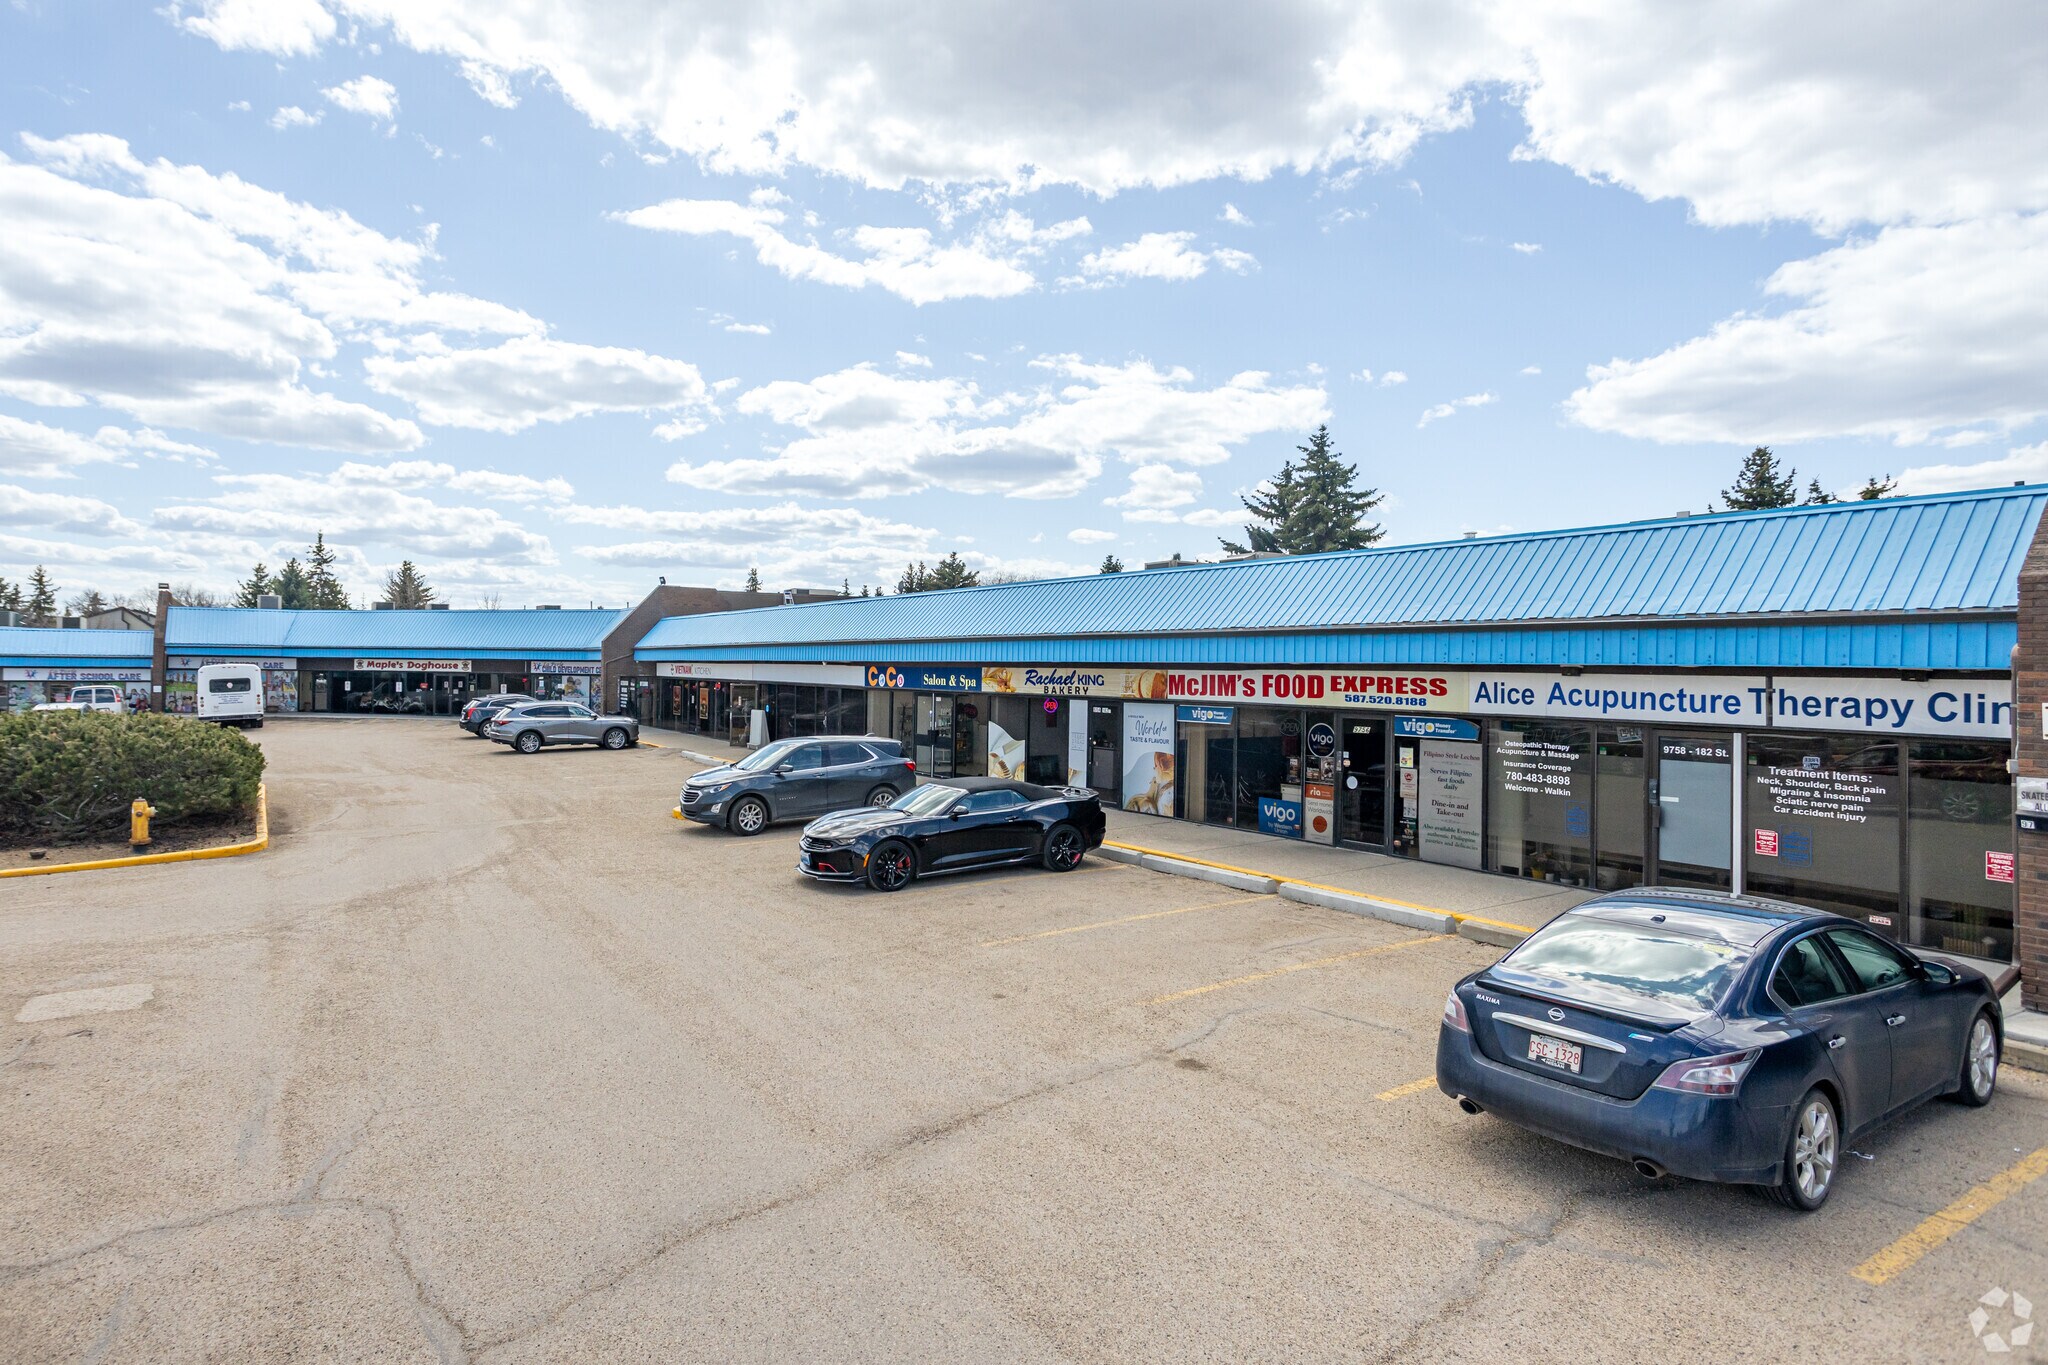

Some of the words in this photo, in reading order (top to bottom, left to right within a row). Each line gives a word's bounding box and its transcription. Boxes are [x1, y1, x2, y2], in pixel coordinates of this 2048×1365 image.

[367, 661, 404, 670] Maple's
[407, 662, 458, 670] Doghouse
[48, 672, 77, 680] AFTER
[923, 674, 946, 686] Salon
[949, 674, 956, 686] &
[960, 674, 976, 689] Spa
[1025, 669, 1076, 686] Rachael
[1078, 674, 1104, 686] KING
[1044, 686, 1089, 695] BAKERY
[1168, 674, 1256, 698] McJIM's
[1262, 674, 1324, 699] FOOD
[1330, 676, 1448, 697] EXPRESS
[1344, 694, 1427, 706] 587.520.8188
[1474, 682, 1535, 705] Alice
[1547, 682, 1741, 714] Acupuncture
[1748, 688, 1914, 728] Therapy
[1192, 708, 1213, 721] vigo
[1135, 720, 1163, 736] World
[1403, 719, 1435, 735] vigo
[1311, 732, 1333, 745] vigo
[1505, 741, 1542, 749] Osteopathic
[1543, 743, 1570, 752] Therapy
[1663, 746, 1686, 755] 9758
[1695, 748, 1712, 756] 182
[1715, 749, 1729, 757] St.
[1424, 751, 1444, 759] Filipino
[1496, 748, 1539, 756] Acupuncture
[1548, 751, 1579, 760] Massage
[1504, 760, 1536, 769] Insurance
[1538, 763, 1571, 772] Coverage
[1450, 769, 1472, 778] Filipino
[1506, 771, 1570, 785] 780-483-8898
[1768, 766, 1830, 779] Treatment
[1832, 771, 1872, 783] Items:
[1310, 787, 1321, 796] ria
[1505, 783, 1538, 793] Welcome
[1545, 787, 1571, 796] Walkin
[1757, 776, 1783, 786] Neck,
[1785, 778, 1832, 790] Shoulder,
[1834, 783, 1860, 792] Back
[1863, 786, 1886, 795] pain
[1770, 787, 1811, 797] Migraine
[1823, 792, 1871, 803] insomnia
[1432, 799, 1455, 808] Dine-in
[1776, 797, 1808, 806] Sciatic
[1811, 801, 1838, 809] nerve
[1841, 803, 1864, 813] pain
[1264, 802, 1295, 822] vigo
[1436, 808, 1464, 818] Take-out
[1792, 808, 1834, 819] accident
[1837, 812, 1866, 823] injury
[1476, 994, 1499, 1005] MAXIMA
[1530, 1041, 1580, 1065] CSC-1328
